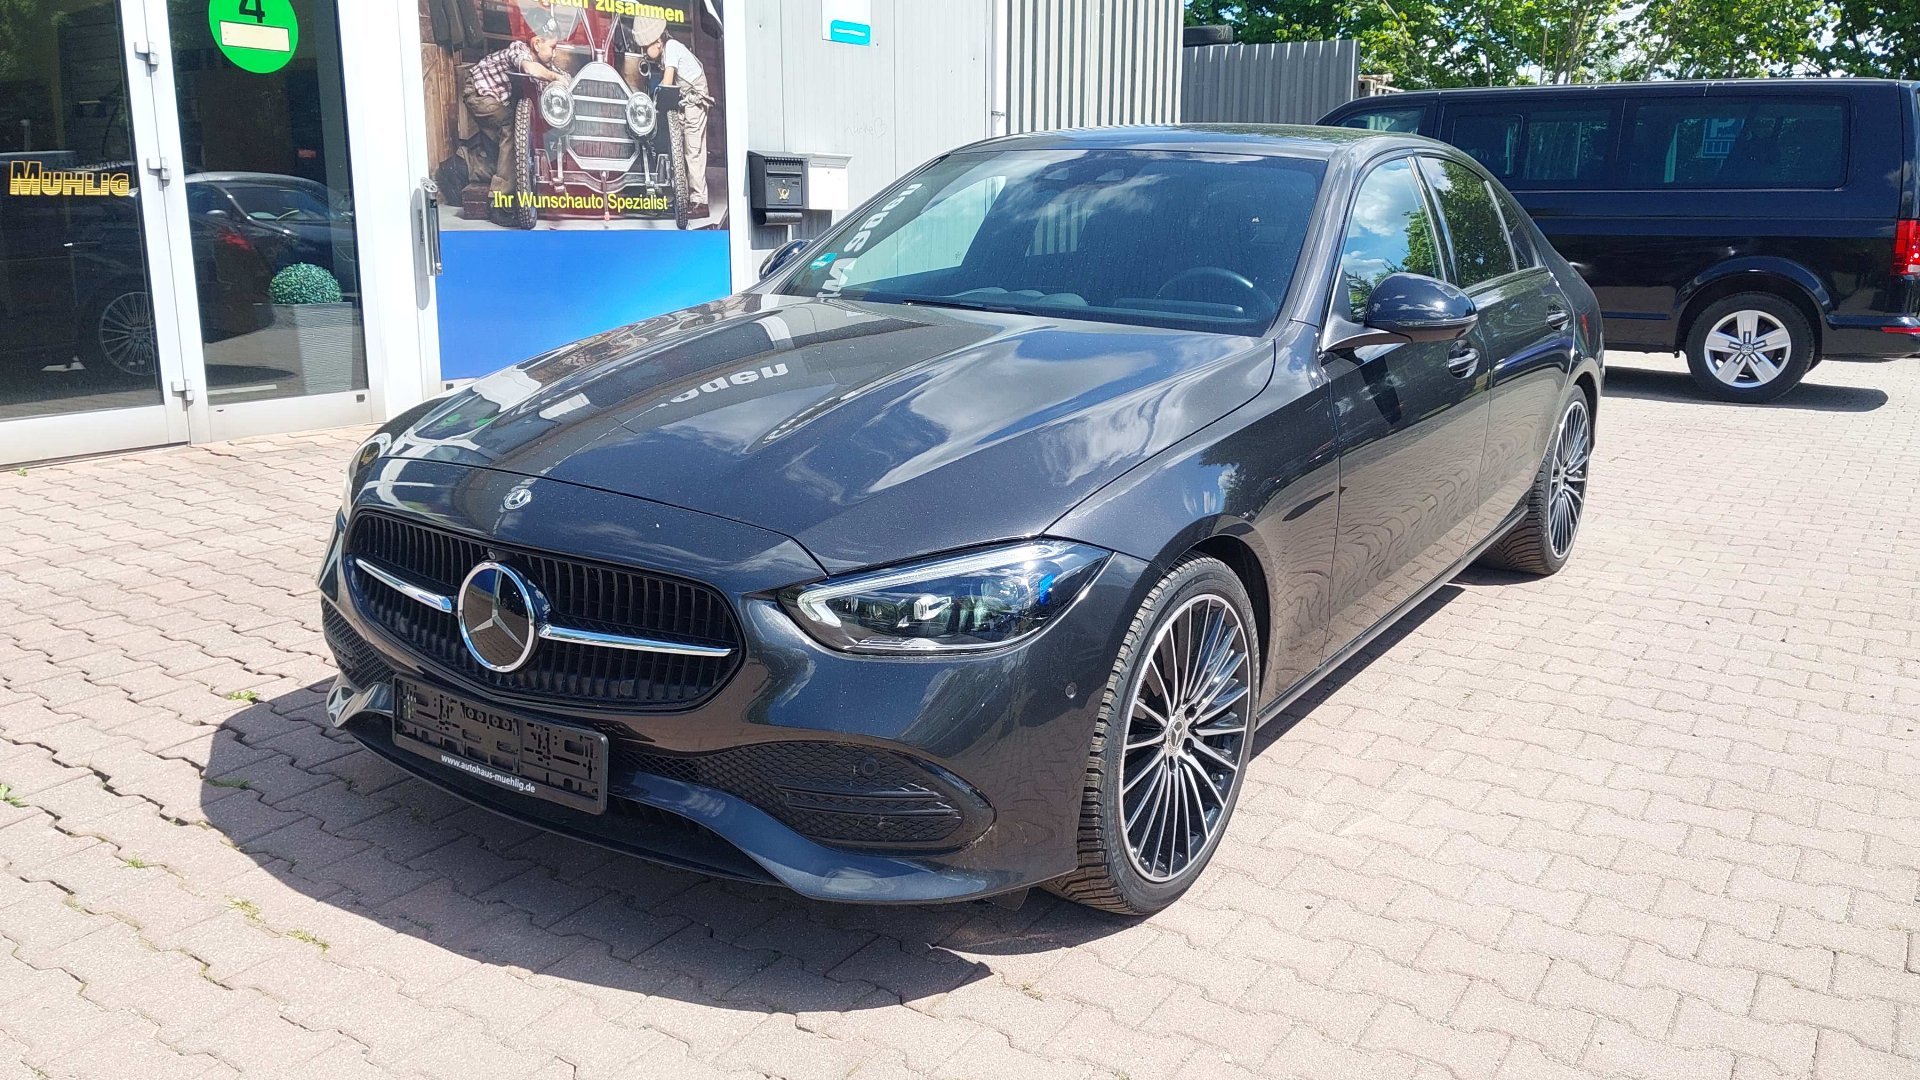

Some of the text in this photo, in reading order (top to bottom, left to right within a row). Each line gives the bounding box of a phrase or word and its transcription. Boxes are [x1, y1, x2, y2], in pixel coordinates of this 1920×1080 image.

[239, 0, 266, 23] 4
[595, 0, 685, 23] zusammen
[493, 190, 668, 212] Ihr Wunschauto Spezialist
[441, 754, 536, 793] www.autohaus-muehlig.de
